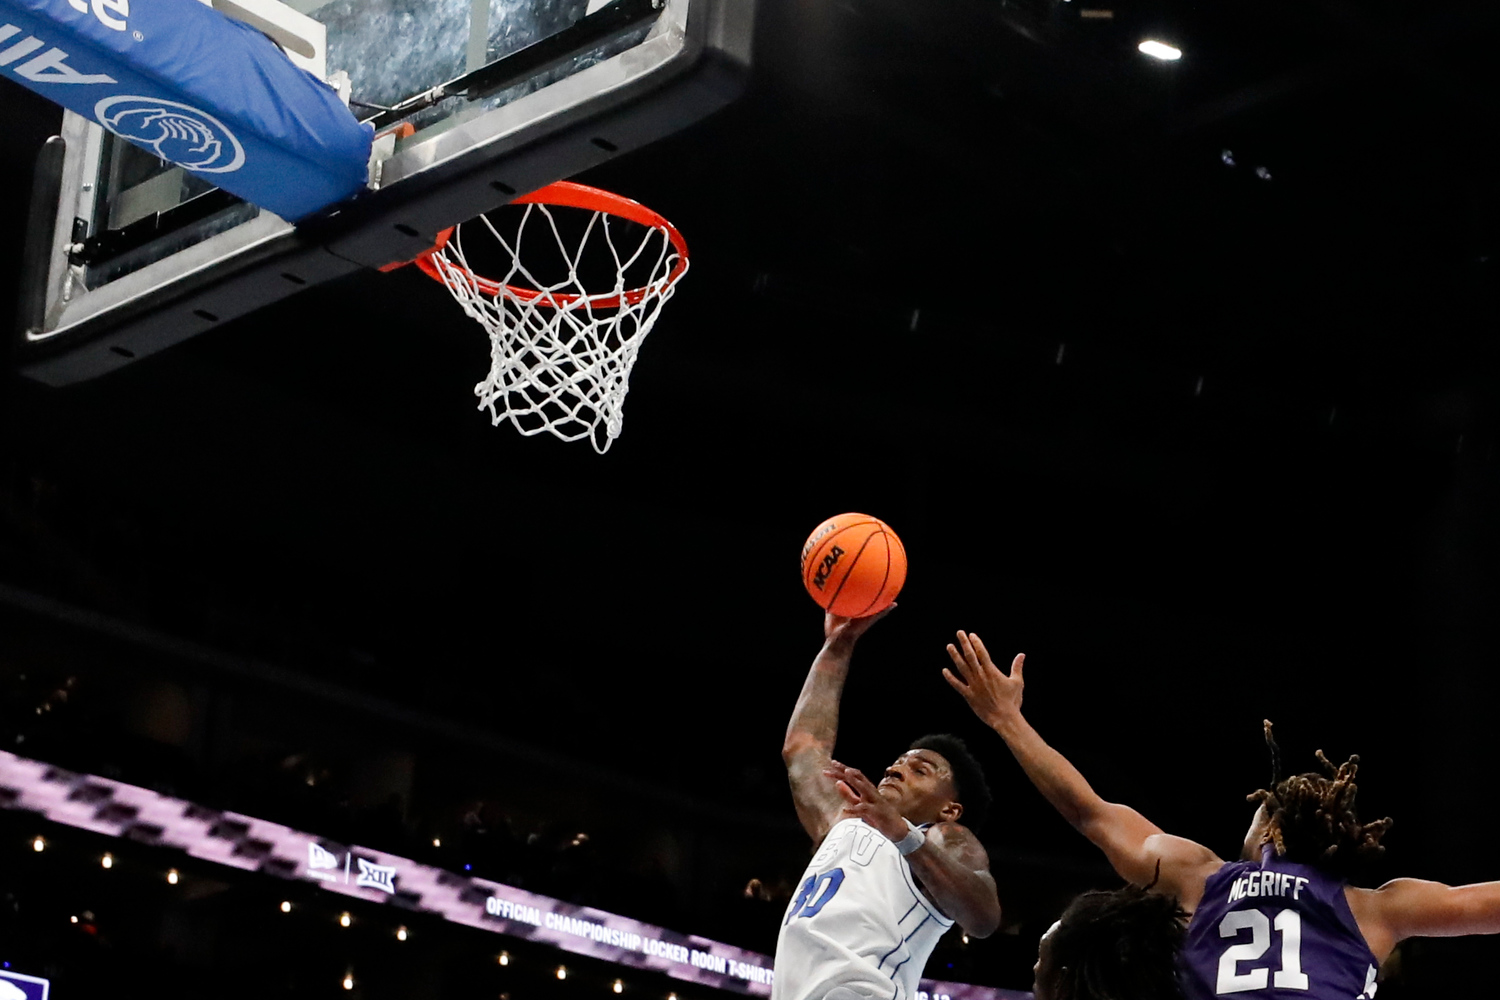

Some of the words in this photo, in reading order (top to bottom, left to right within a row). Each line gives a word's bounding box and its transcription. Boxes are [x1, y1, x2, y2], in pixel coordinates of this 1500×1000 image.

[813, 545, 845, 591] NCAA
[486, 896, 542, 926] OFFICIAL
[545, 911, 641, 950] CHAMPIONSHIP
[643, 936, 688, 965] LOCKER
[691, 949, 725, 973] ROOM
[1216, 908, 1309, 995] 21
